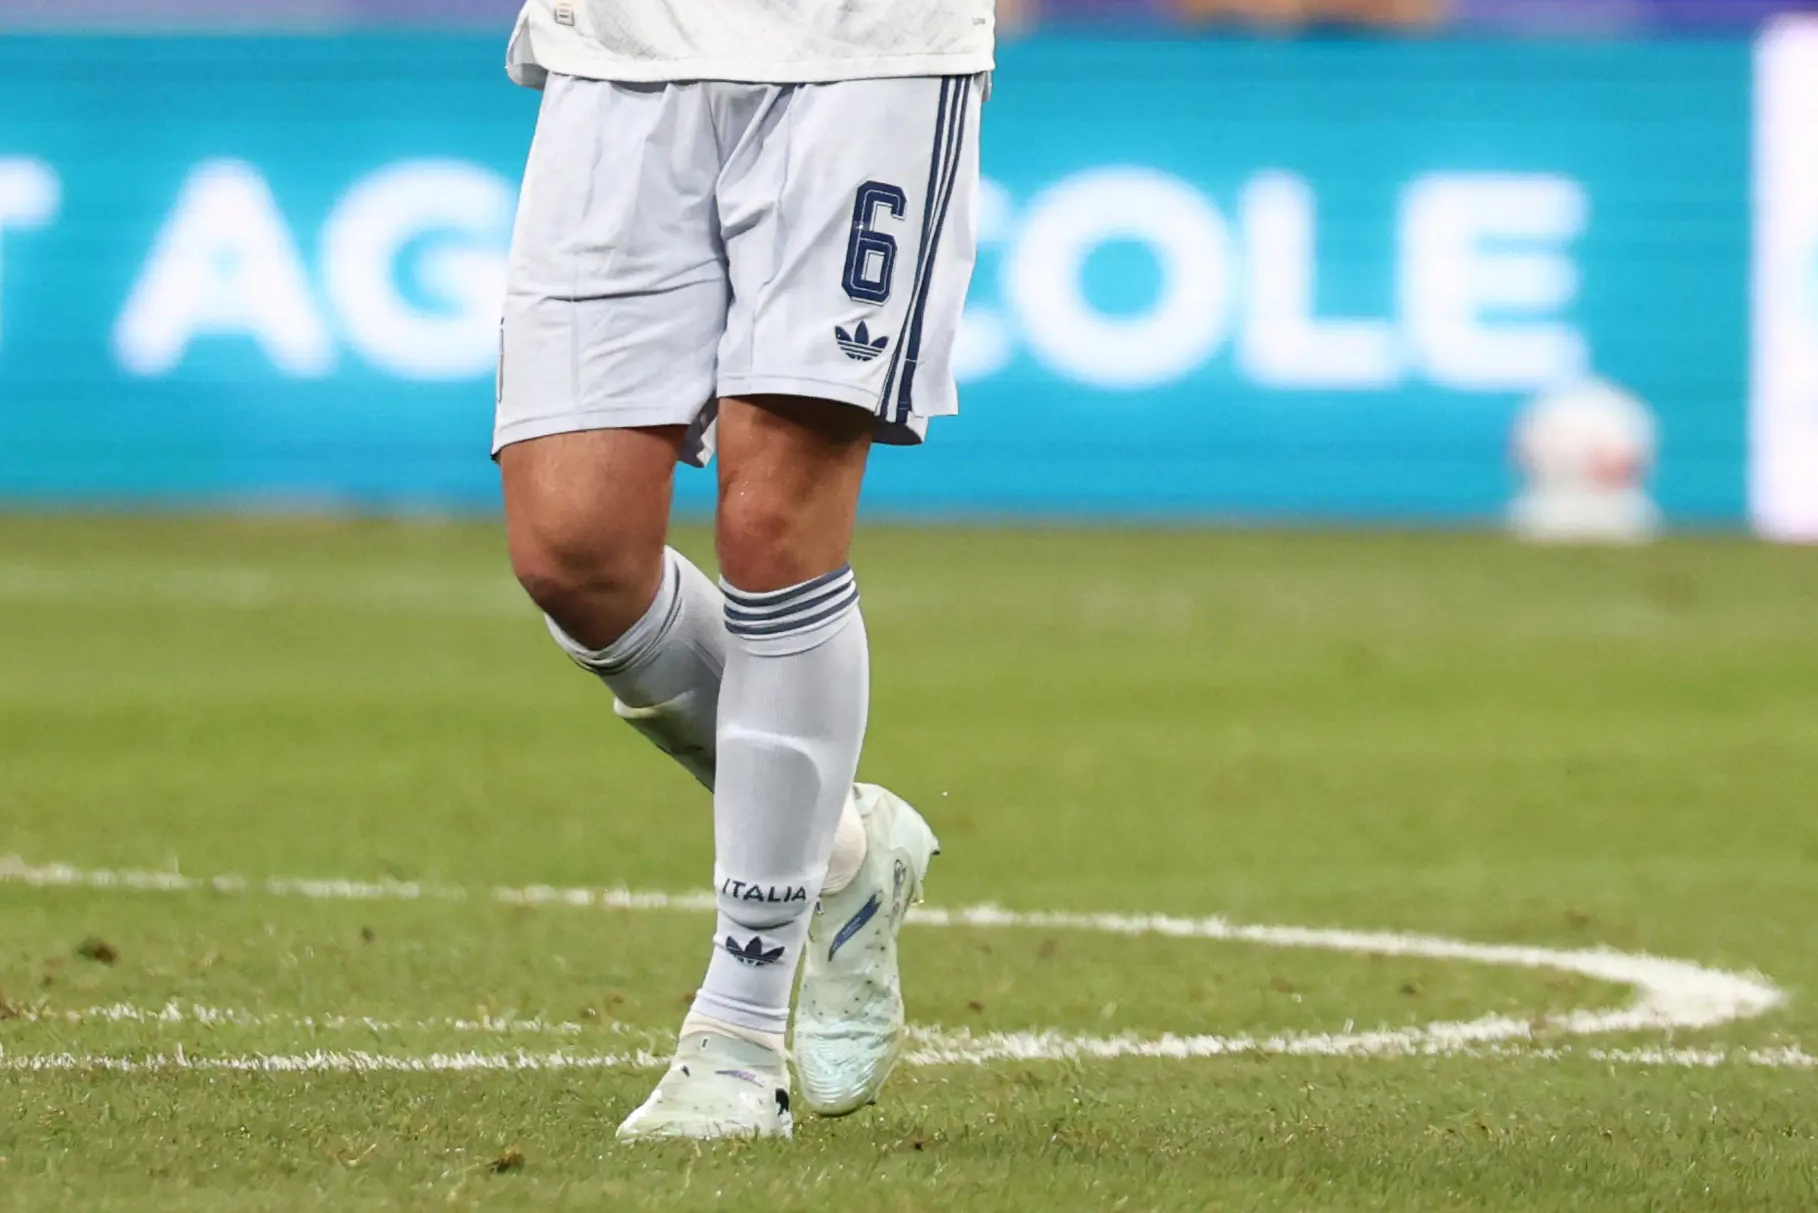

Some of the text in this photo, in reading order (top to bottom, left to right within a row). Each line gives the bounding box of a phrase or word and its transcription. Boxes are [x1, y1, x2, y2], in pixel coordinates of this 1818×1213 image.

[112, 158, 1588, 390] AGOLE
[842, 180, 908, 306] 6
[722, 878, 807, 902] ITALIA
